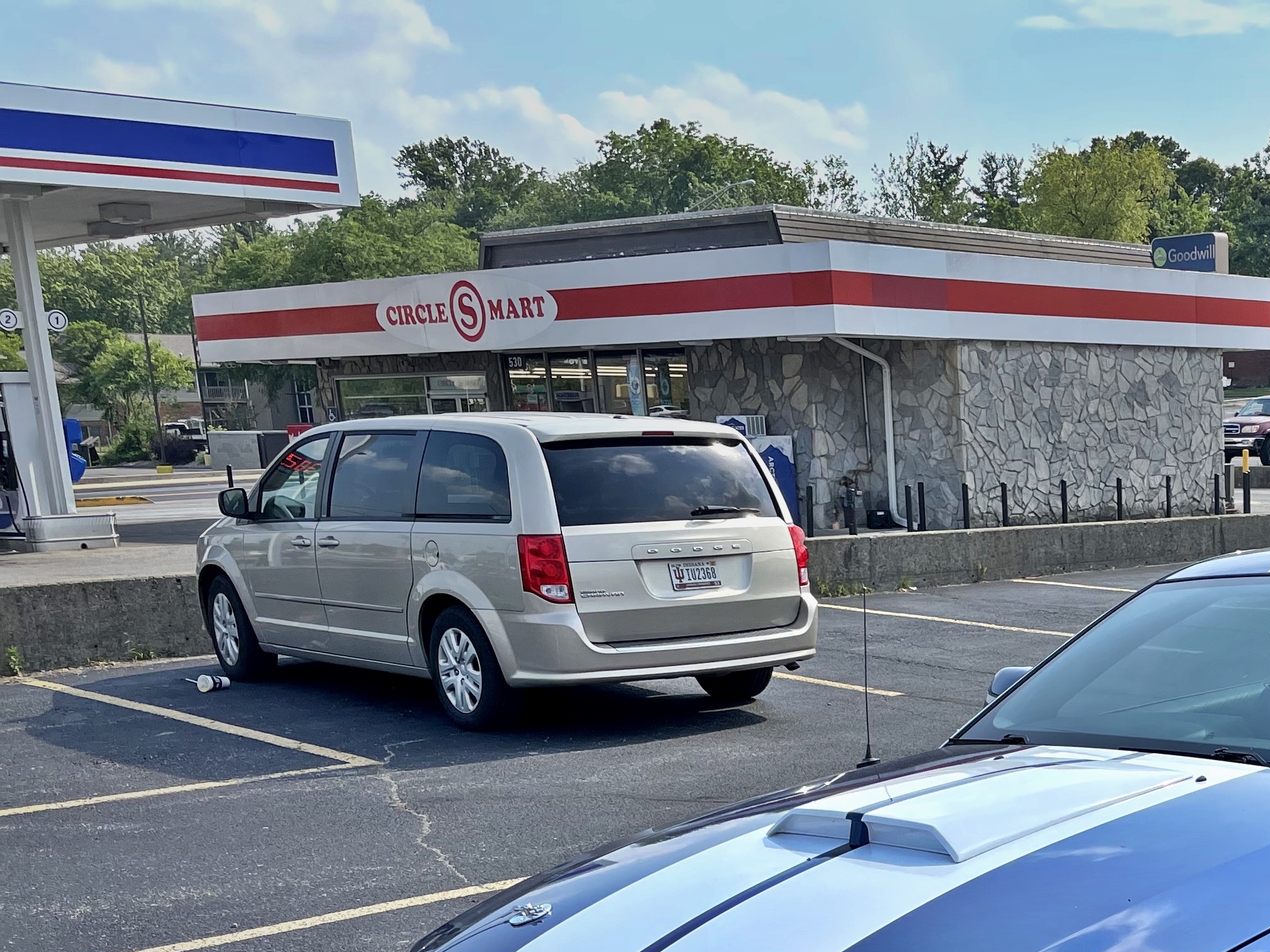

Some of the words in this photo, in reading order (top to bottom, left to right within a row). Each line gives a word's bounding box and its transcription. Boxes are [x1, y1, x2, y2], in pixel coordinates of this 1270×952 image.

[1168, 244, 1215, 263] Goodwill
[386, 302, 449, 326] CIRCLE
[457, 292, 478, 330] S
[487, 295, 545, 321] MART
[5, 315, 11, 324] 2
[508, 357, 522, 367] 530
[647, 543, 741, 555] DODGE
[685, 566, 717, 581] IU2368
